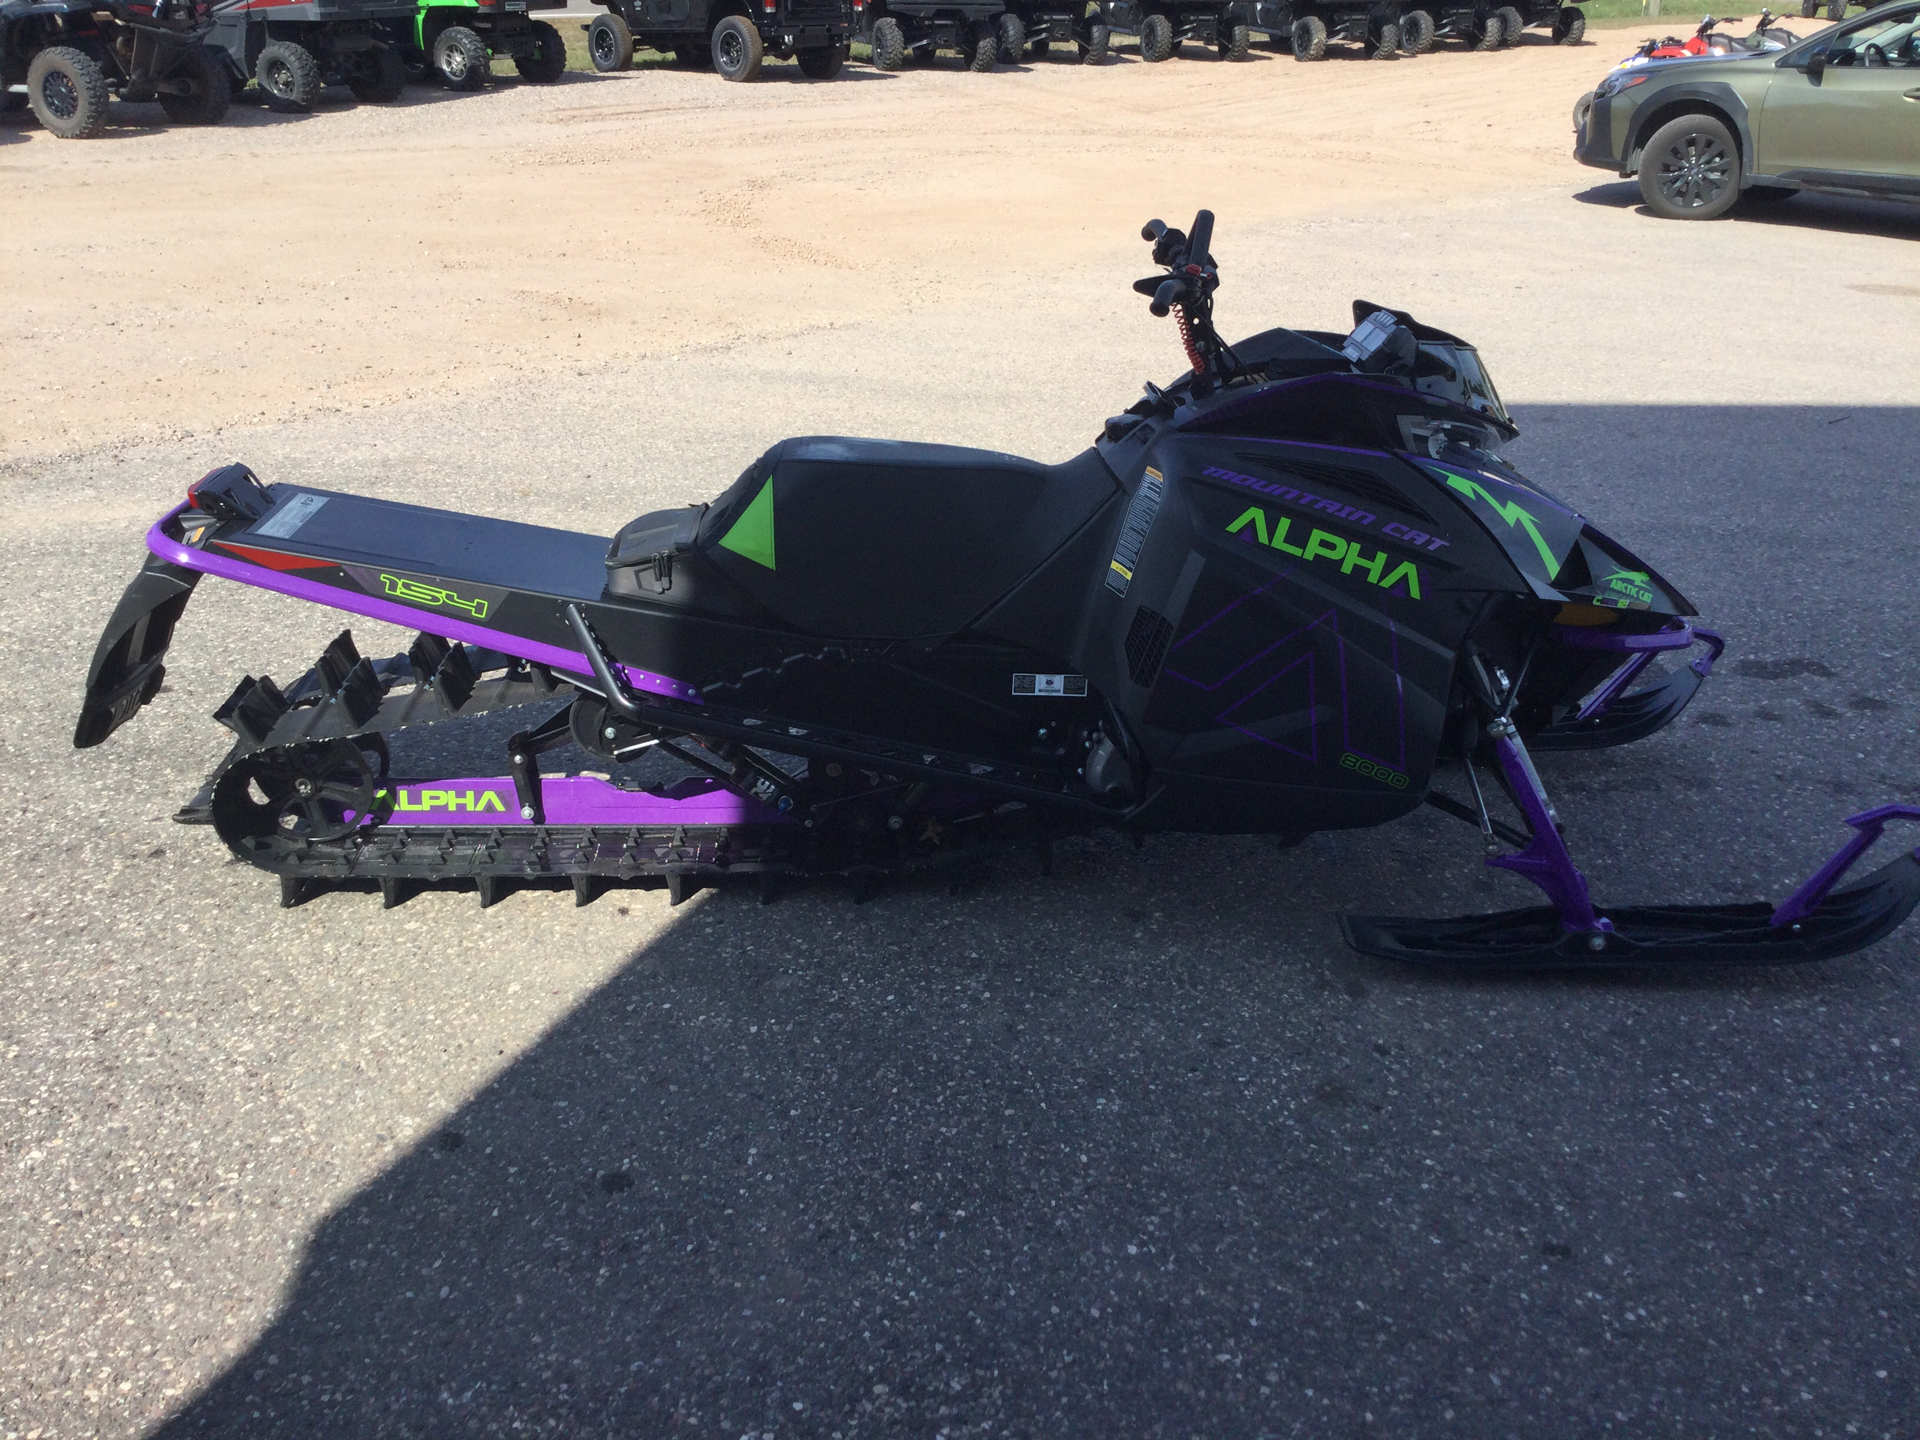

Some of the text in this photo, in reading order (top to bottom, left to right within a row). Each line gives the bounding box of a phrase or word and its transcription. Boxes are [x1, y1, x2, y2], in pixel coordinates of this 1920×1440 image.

[1201, 466, 1378, 525] MOUNTAIN
[1381, 522, 1451, 551] CAT
[1225, 506, 1421, 600] ALPHA
[380, 573, 488, 619] 154
[1610, 579, 1638, 597] ARCTIC
[1639, 589, 1653, 603] CAT
[1340, 752, 1410, 789] 8000
[371, 789, 506, 811] ALPHA
